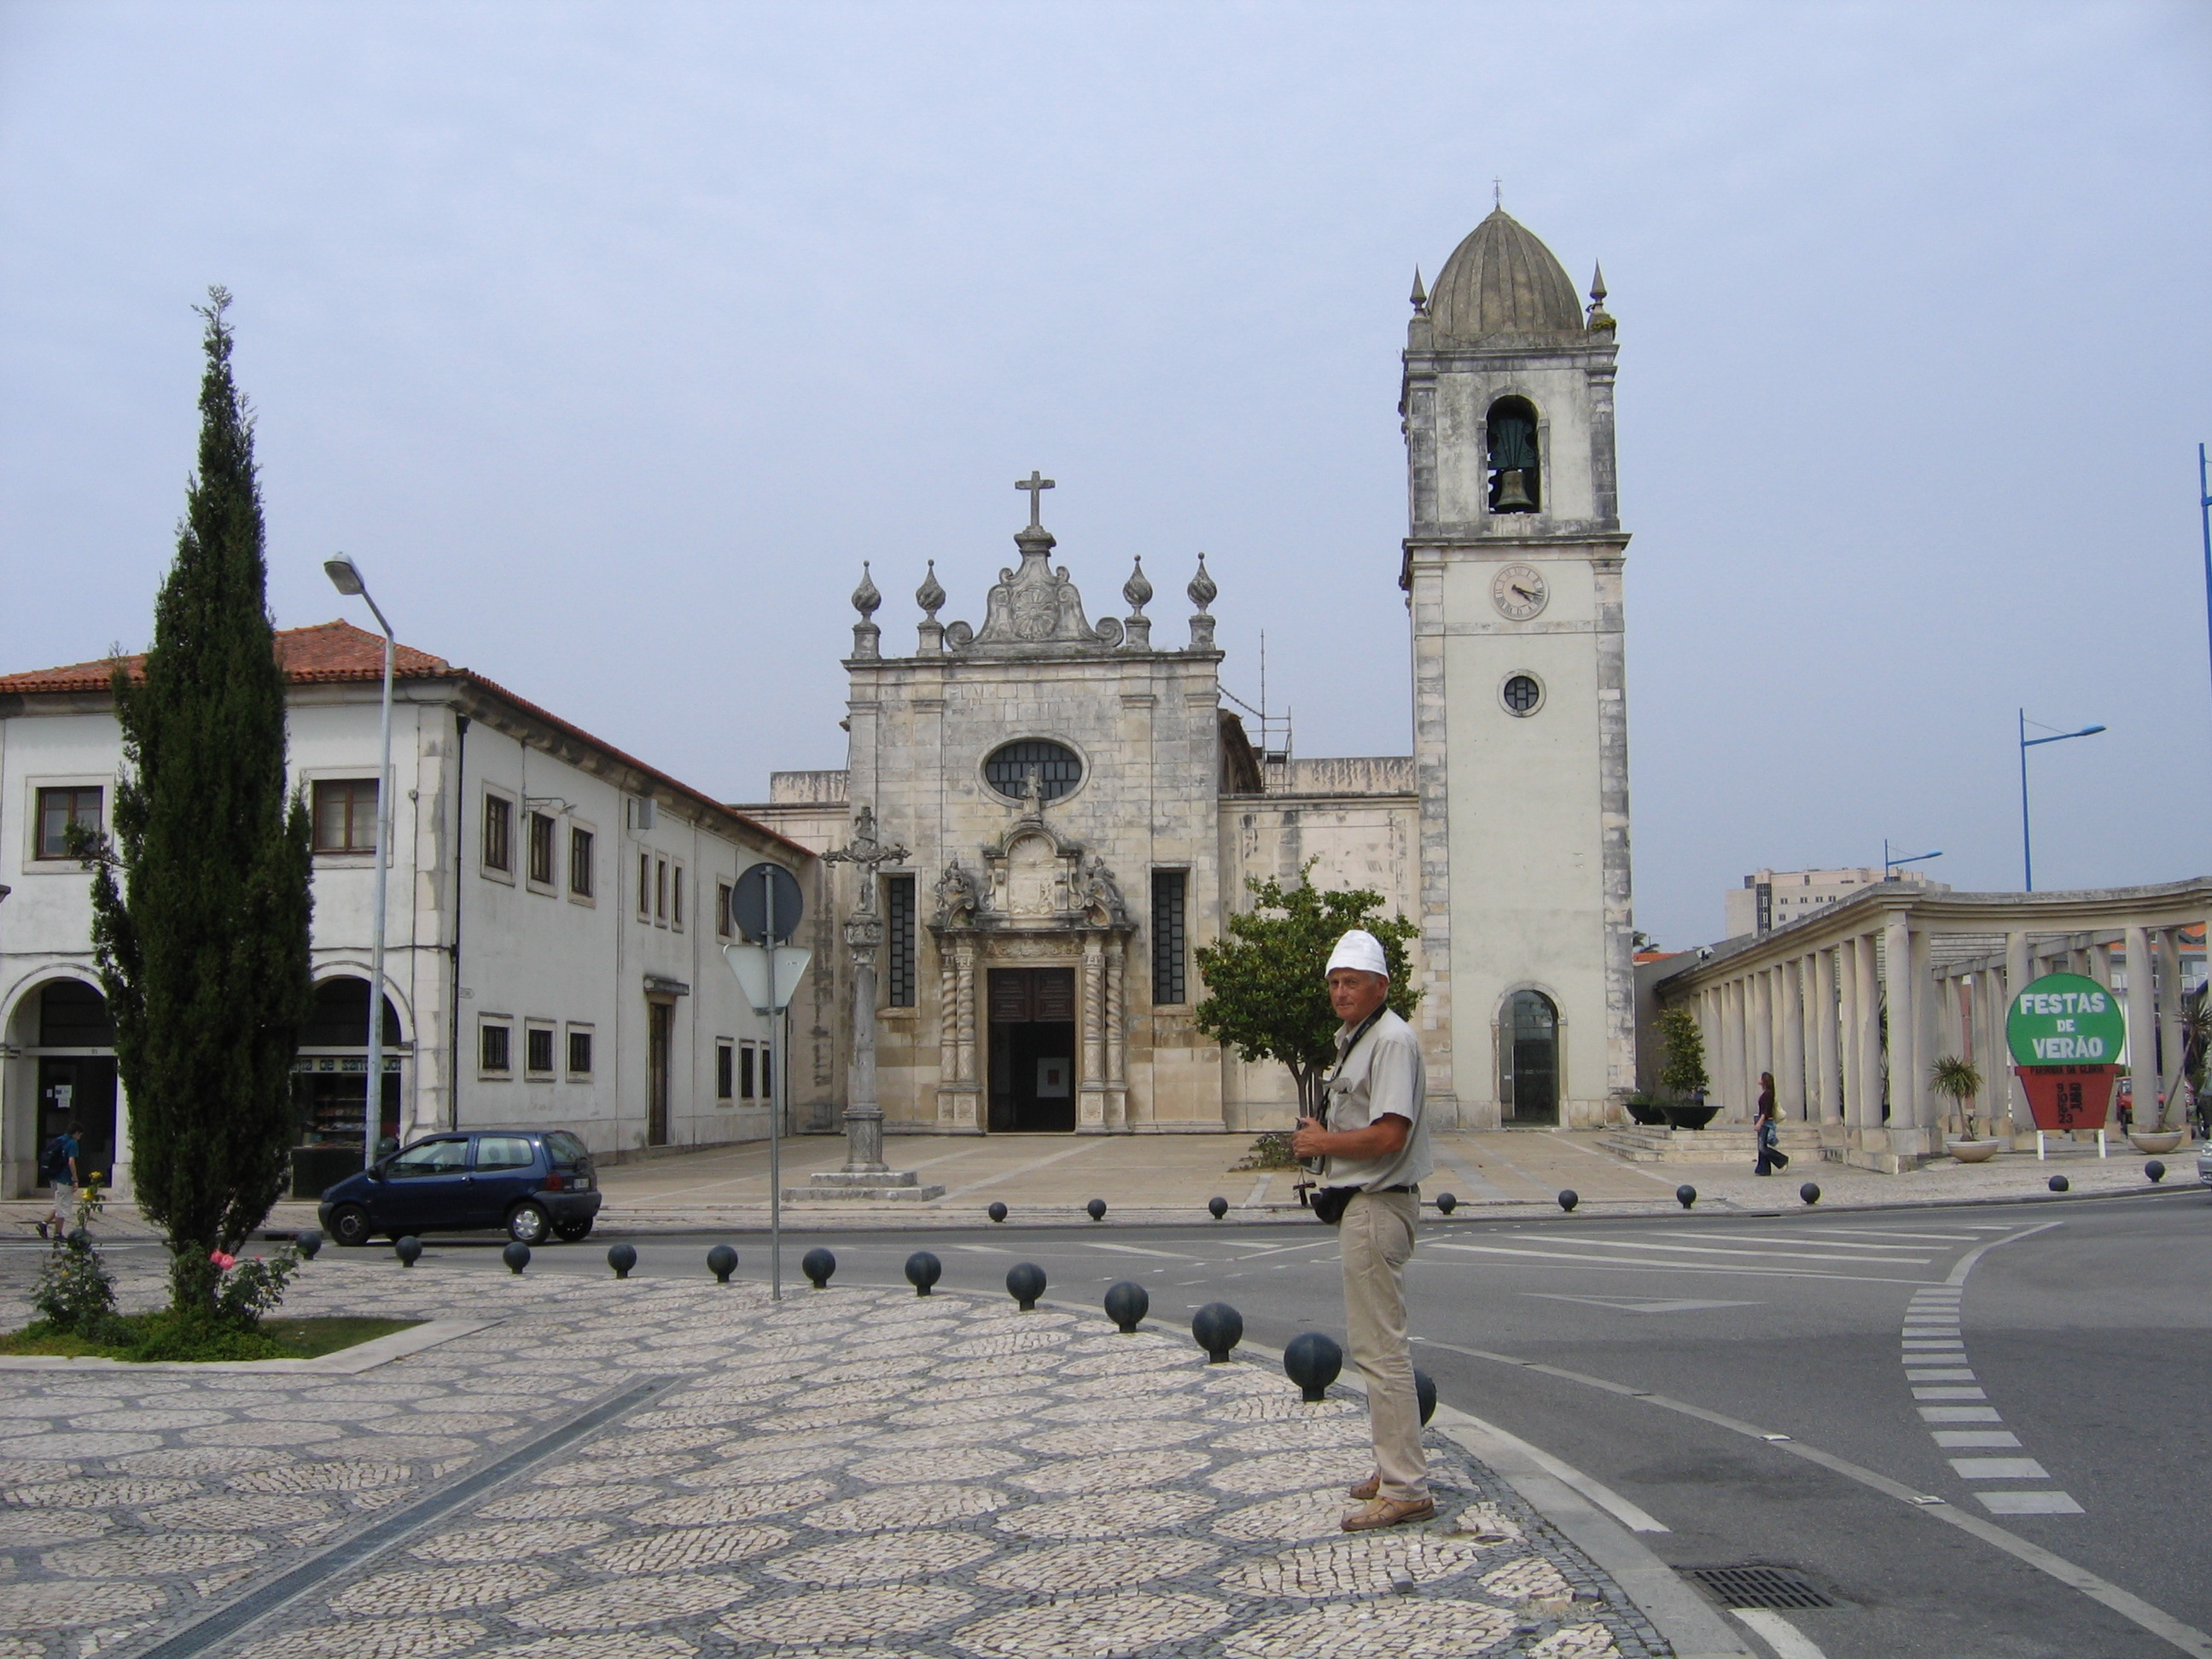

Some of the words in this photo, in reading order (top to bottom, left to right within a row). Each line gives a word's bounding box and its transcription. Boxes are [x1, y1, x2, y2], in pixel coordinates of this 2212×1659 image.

[2020, 992, 2105, 1015] FESTAS
[2057, 1019, 2075, 1033] DE
[2032, 1035, 2104, 1059] VERÃO
[2058, 1114, 2074, 1124] 23
